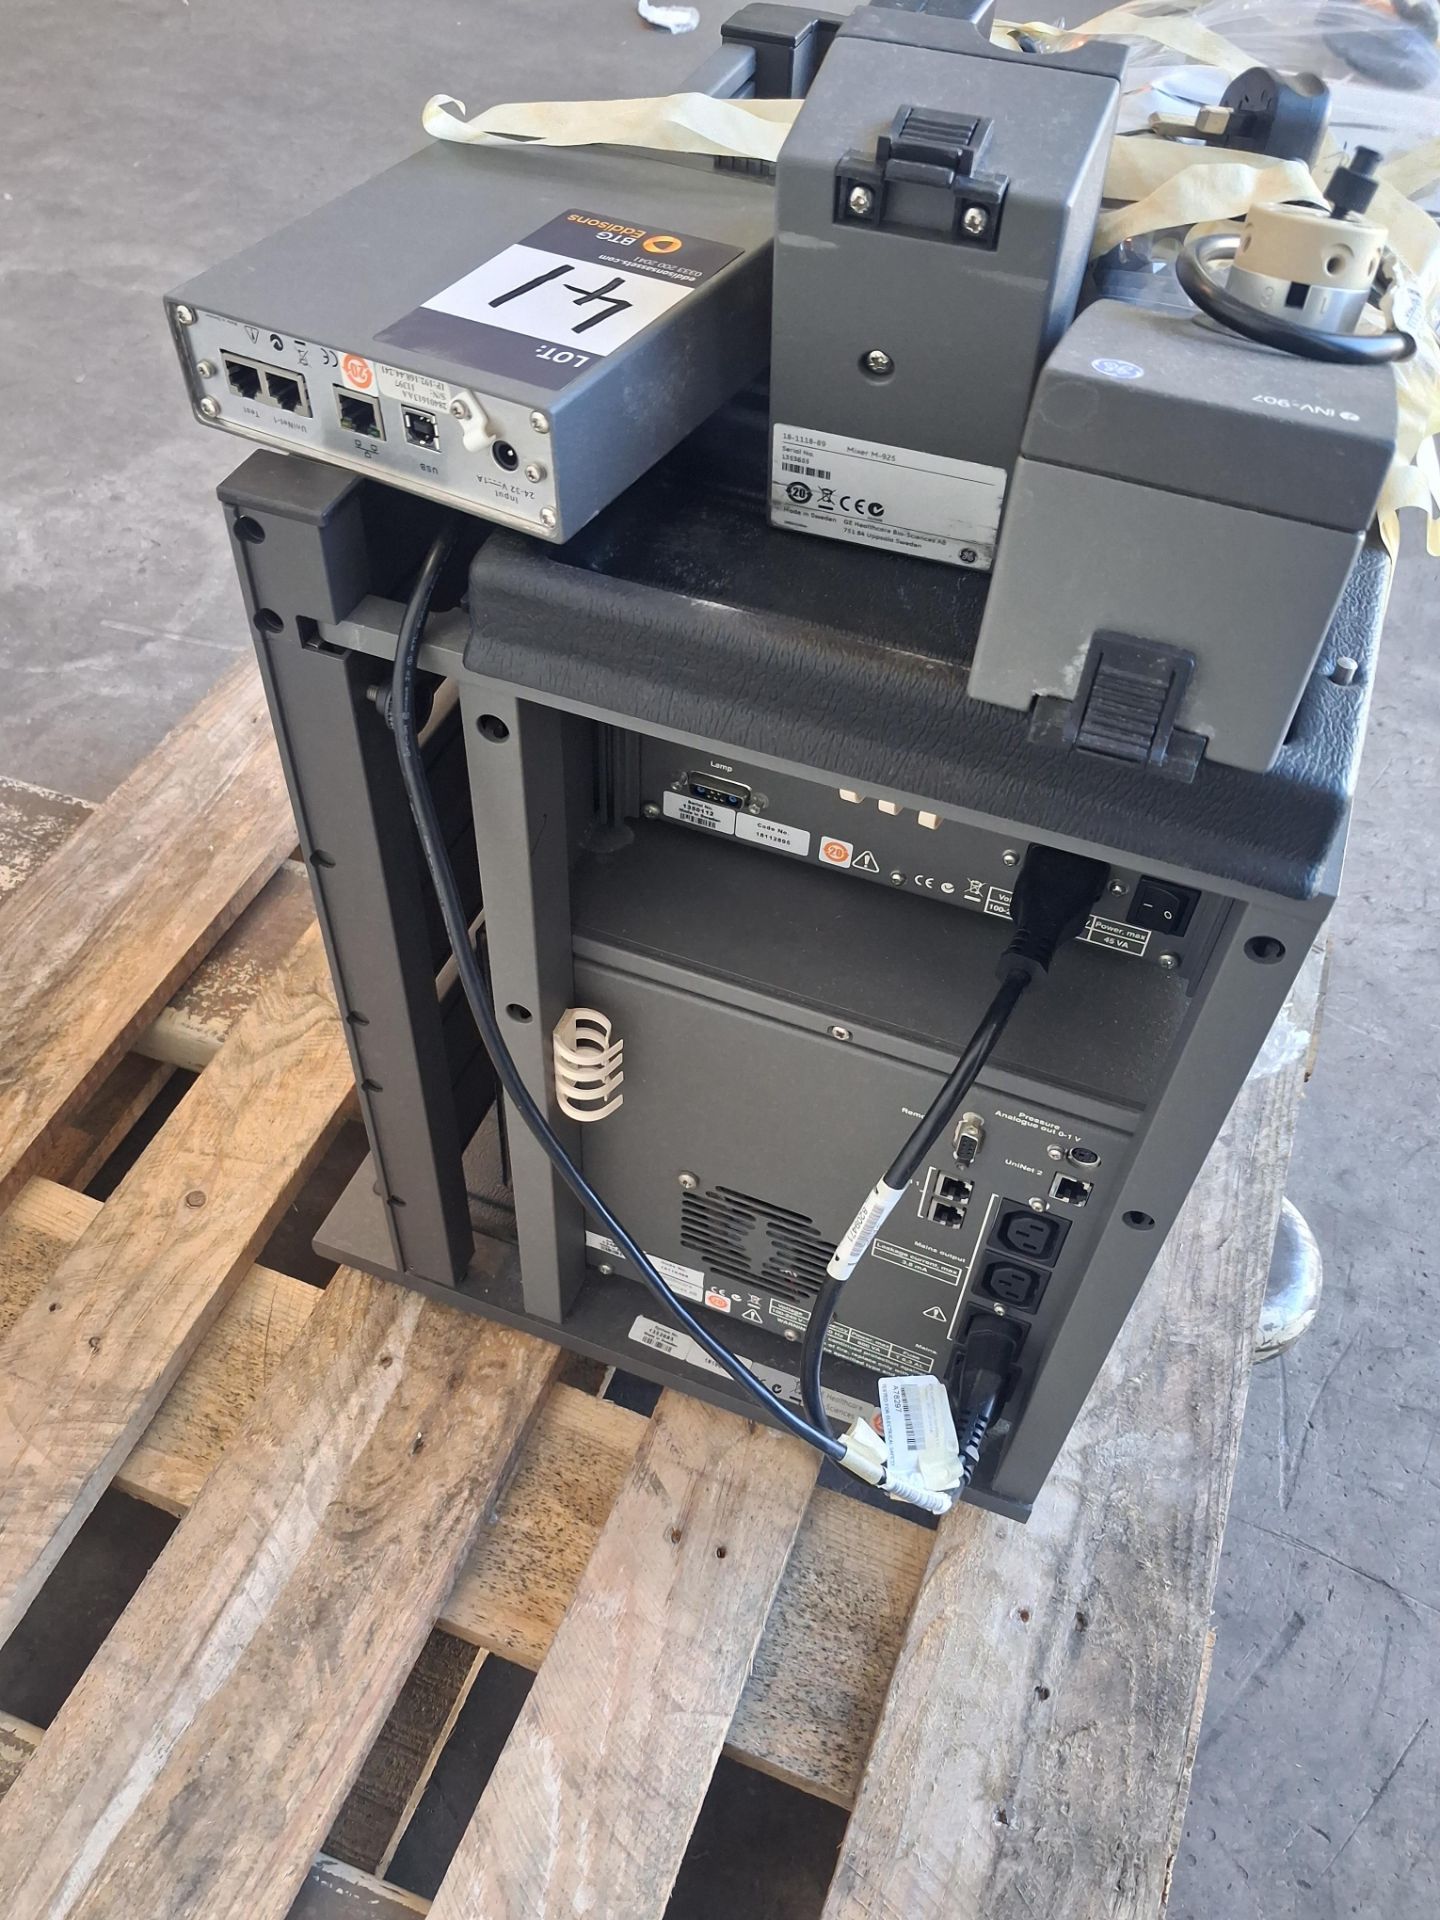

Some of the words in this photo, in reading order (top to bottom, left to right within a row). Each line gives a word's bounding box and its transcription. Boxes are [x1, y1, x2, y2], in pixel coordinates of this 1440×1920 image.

[567, 214, 646, 239] Eddisons
[595, 231, 637, 246] BTG
[598, 254, 696, 282] eddisonsassets.com
[634, 256, 656, 267] 2041
[657, 261, 678, 272] 200
[679, 266, 703, 277] 0333
[488, 264, 633, 334] 41
[536, 345, 590, 368] LOT:
[243, 406, 260, 418] Test
[1251, 394, 1335, 418] INV-907
[273, 417, 307, 433] UniNet-1
[782, 445, 802, 455] Serial
[847, 446, 869, 456] Mixer
[871, 451, 896, 462] M-925
[420, 463, 439, 475] USB
[494, 490, 519, 504] Input
[510, 485, 535, 499] 24-32
[792, 487, 806, 498] 20
[811, 513, 837, 522] Sweden
[854, 522, 891, 534] Healthcare
[895, 539, 922, 548] Sweden
[710, 760, 733, 773] Lamp
[757, 822, 775, 832] Code
[1126, 931, 1146, 940] max
[1103, 936, 1115, 945] 45
[1116, 940, 1129, 949] VA
[995, 1110, 1039, 1129] Analogue
[1040, 1126, 1057, 1135] out
[1018, 1112, 1061, 1130] Pressure
[1005, 1158, 1035, 1173] UniNet
[914, 1241, 938, 1255] Mains
[939, 1250, 966, 1263] output
[876, 1243, 909, 1258] Leakage
[940, 1265, 958, 1275] max
[915, 1343, 938, 1355] Mains
